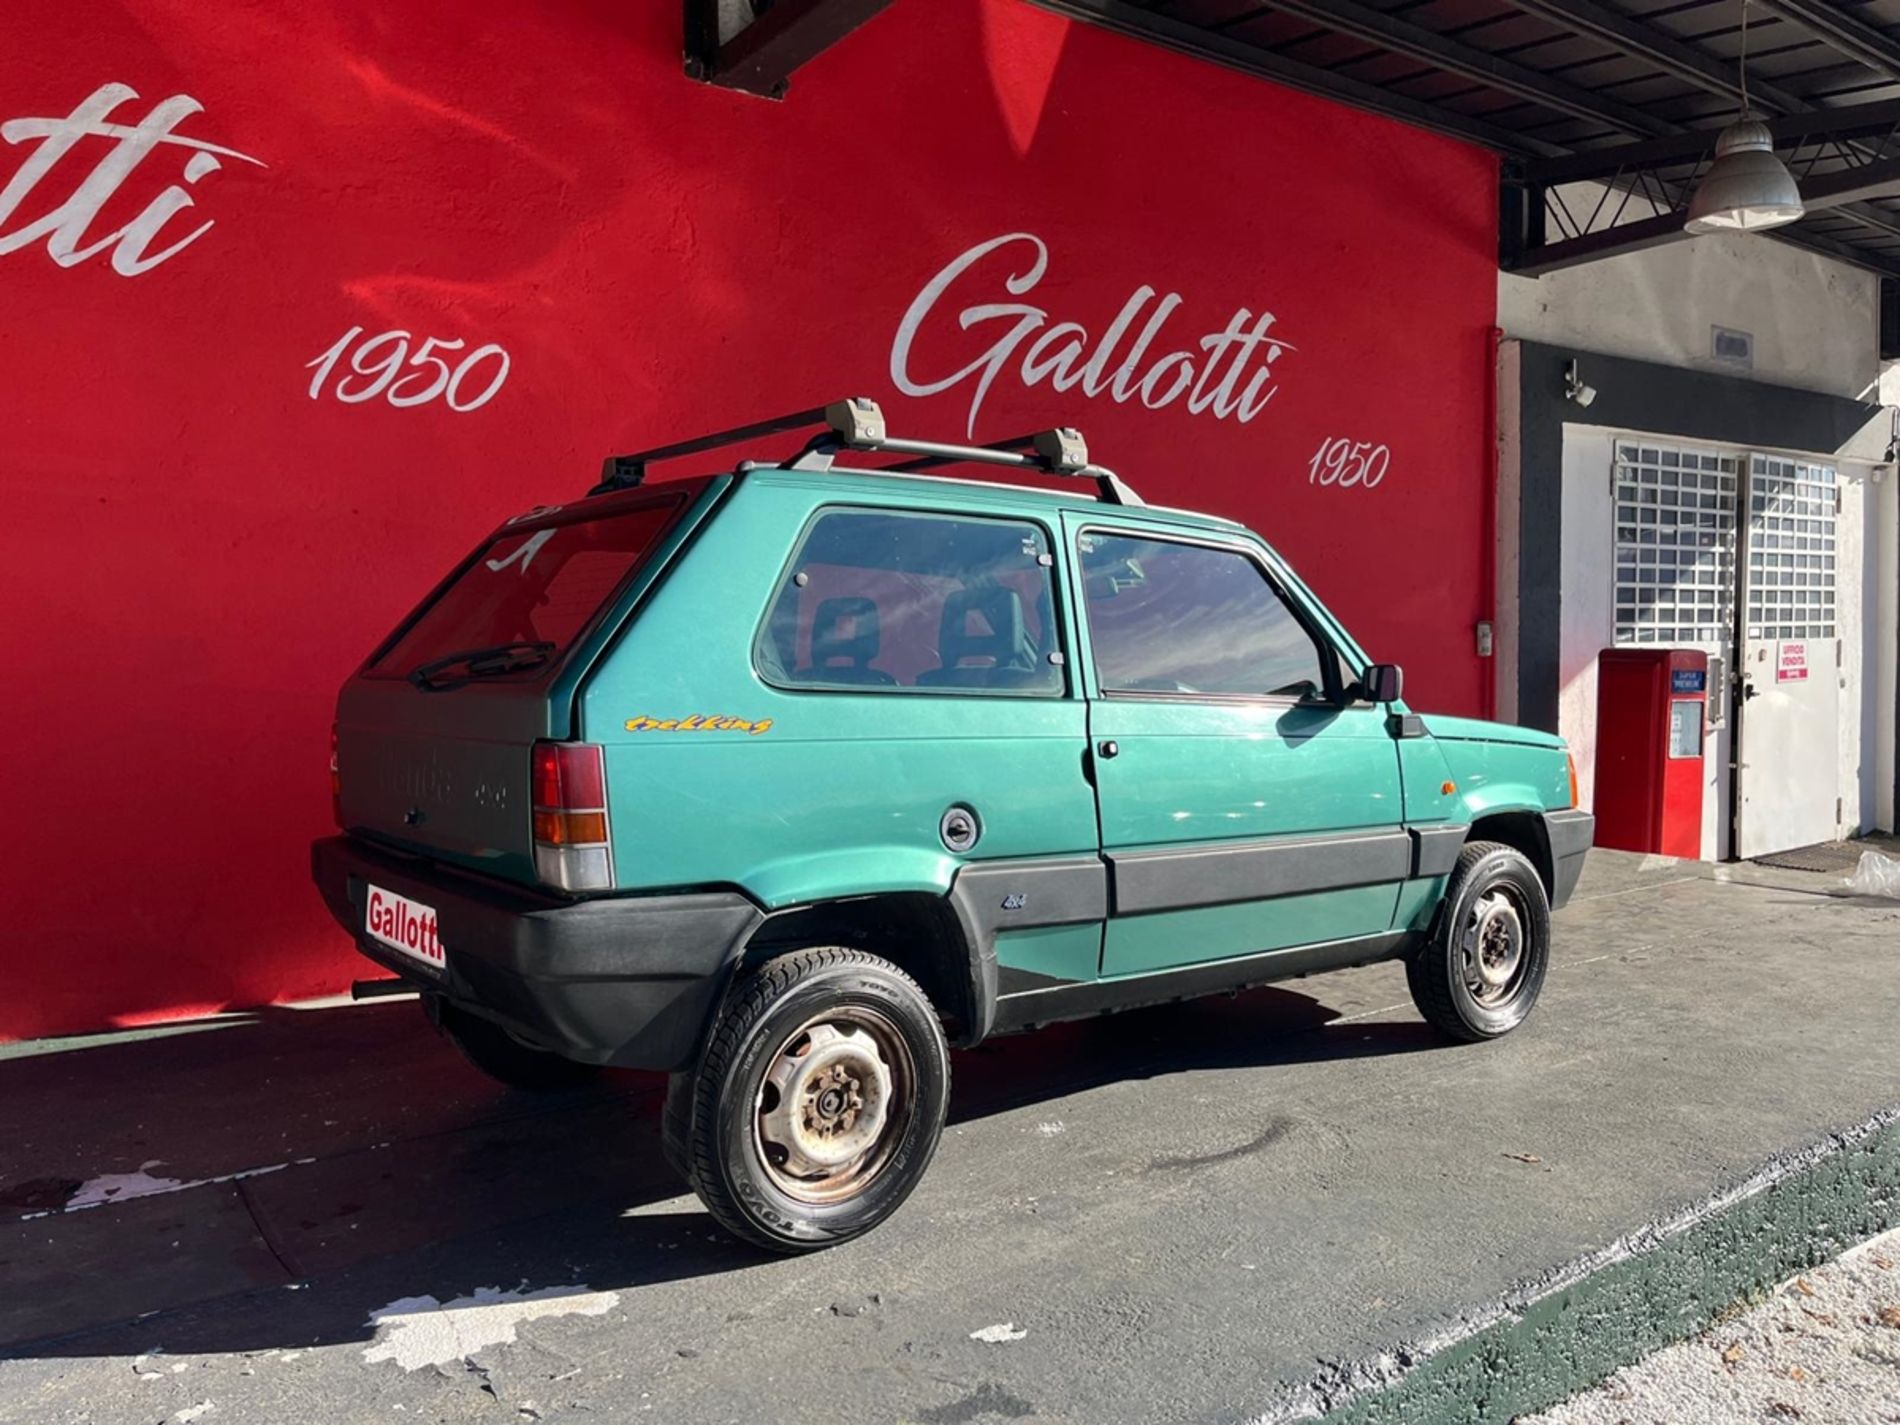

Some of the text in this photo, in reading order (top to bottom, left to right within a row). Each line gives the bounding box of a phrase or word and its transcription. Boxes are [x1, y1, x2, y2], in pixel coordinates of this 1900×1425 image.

[889, 232, 1297, 440] Gallotti
[306, 325, 511, 412] 1950
[1308, 436, 1390, 489] 1950
[624, 713, 773, 736] trekking
[859, 979, 900, 999] TOYO
[738, 1180, 796, 1236] TOYO
